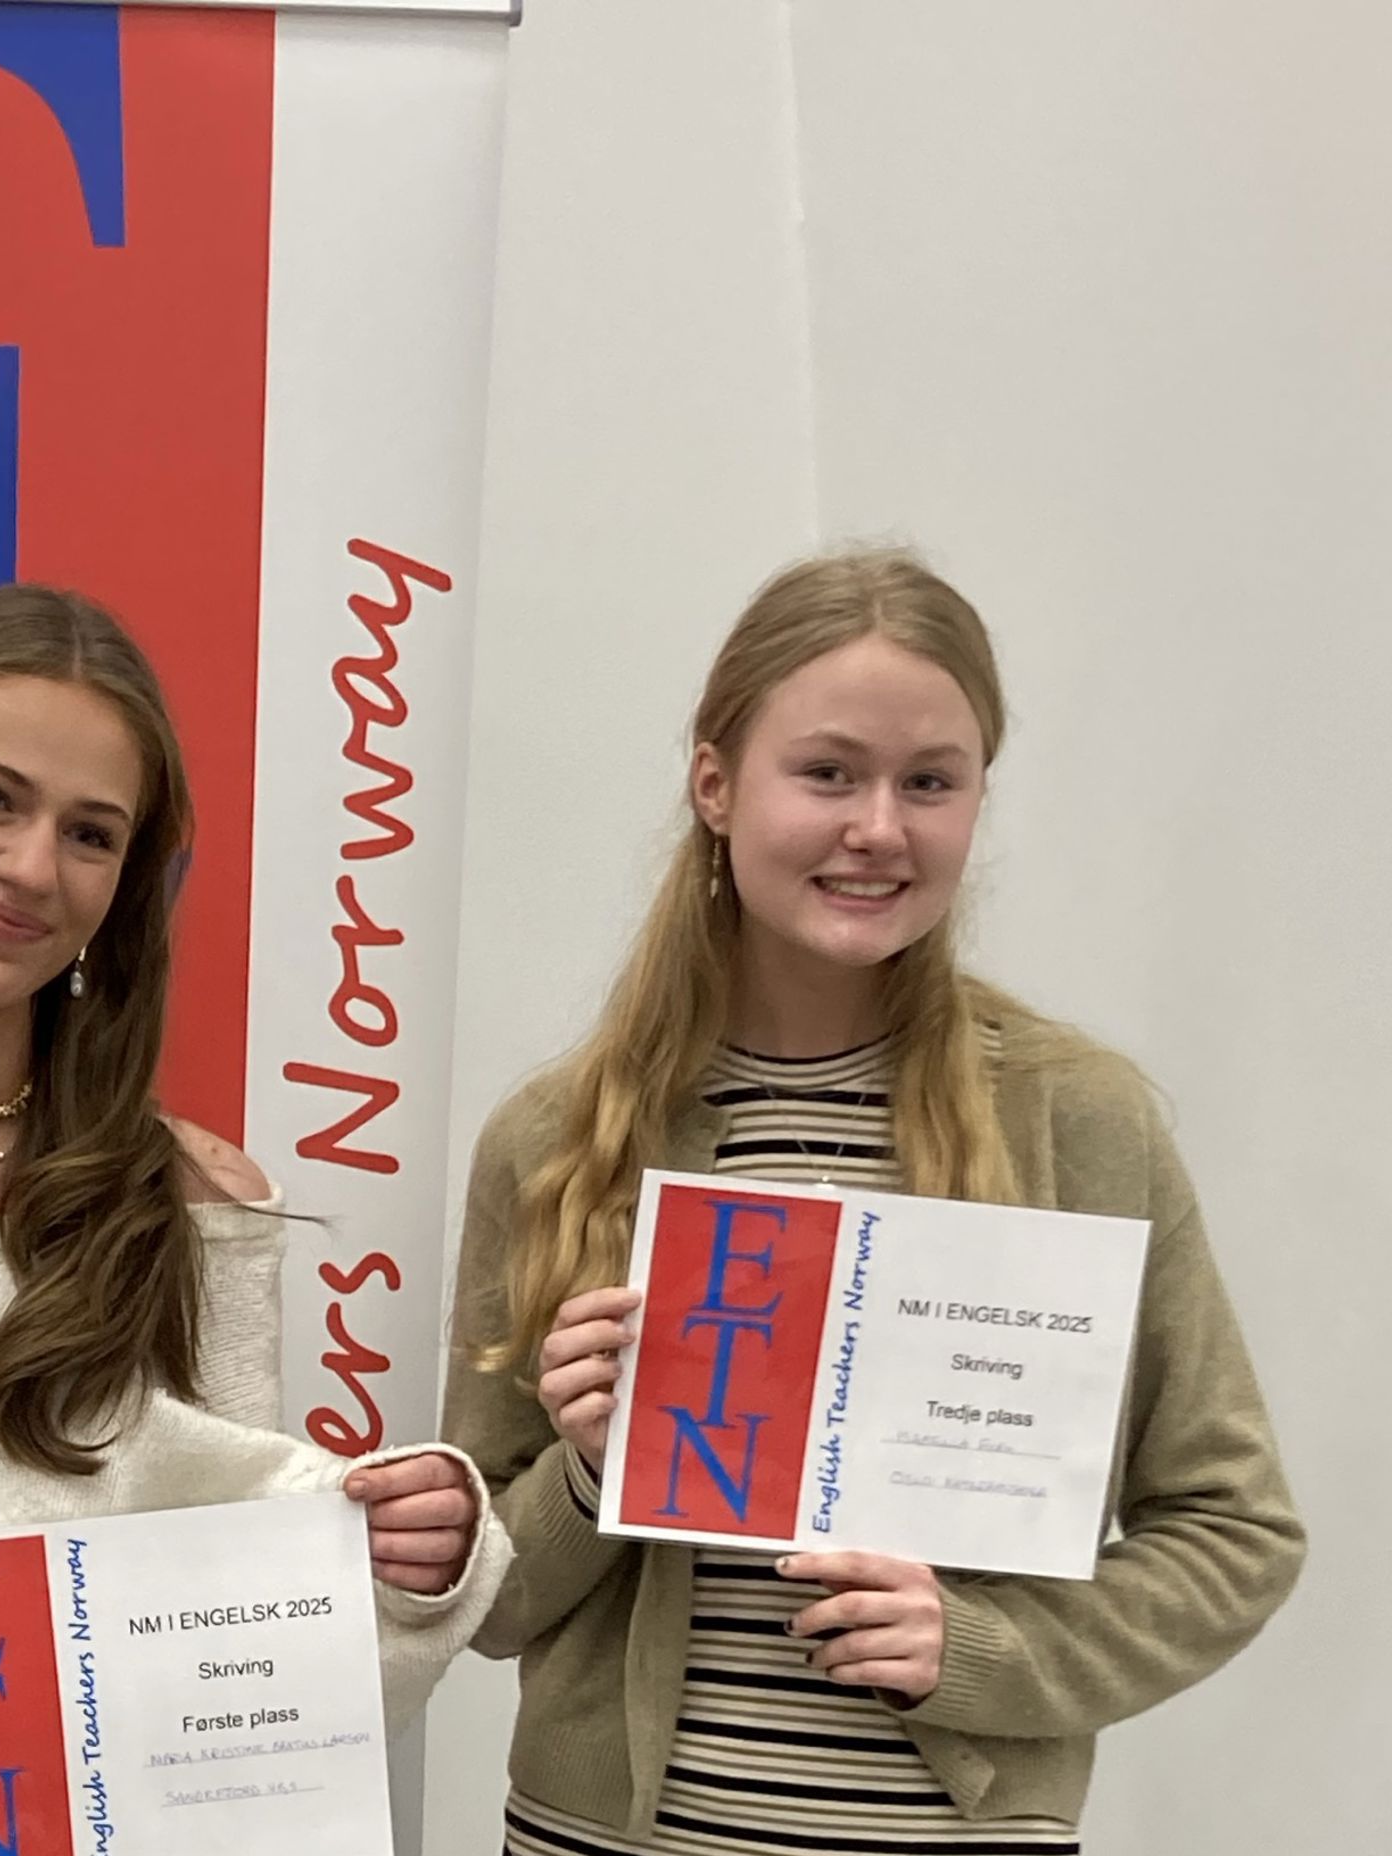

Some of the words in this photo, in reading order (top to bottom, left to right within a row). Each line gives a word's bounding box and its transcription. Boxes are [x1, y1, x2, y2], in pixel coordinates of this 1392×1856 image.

[283, 538, 452, 1174] Norway
[843, 1211, 881, 1310] Norway
[897, 1298, 931, 1317] NM
[934, 1302, 941, 1318] I
[945, 1303, 1043, 1328] ENGELSK
[1046, 1313, 1093, 1334] 2025
[825, 1322, 860, 1428] Teachers
[950, 1353, 1023, 1380] Skriving
[926, 1400, 981, 1425] Tredje
[986, 1409, 1033, 1428] plass
[812, 1435, 843, 1533] English
[67, 1538, 89, 1640] Norway
[128, 1615, 162, 1636] NM
[167, 1614, 174, 1631] I
[179, 1602, 281, 1631] ENGELSK
[286, 1596, 333, 1618] 2025
[198, 1659, 274, 1680] Skriving
[76, 1650, 97, 1764] Teachers
[182, 1712, 244, 1733] Første
[249, 1708, 300, 1730] plass
